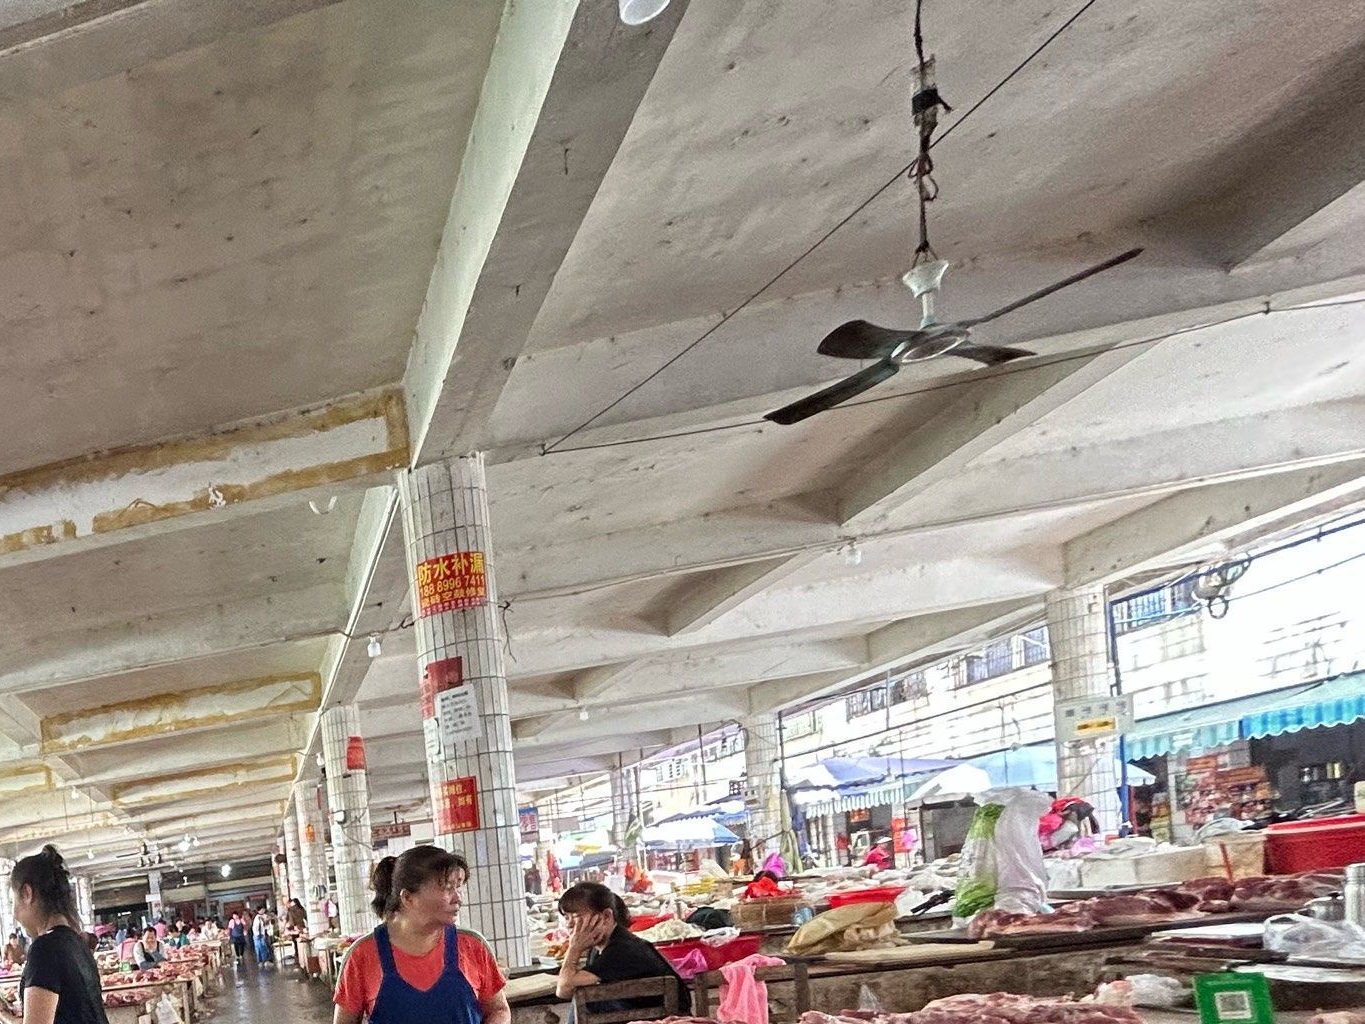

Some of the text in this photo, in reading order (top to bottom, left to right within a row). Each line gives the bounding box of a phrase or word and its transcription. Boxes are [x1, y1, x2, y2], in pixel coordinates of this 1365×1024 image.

[418, 553, 484, 586] 防水补漏
[420, 575, 485, 598] 188 8996 7411
